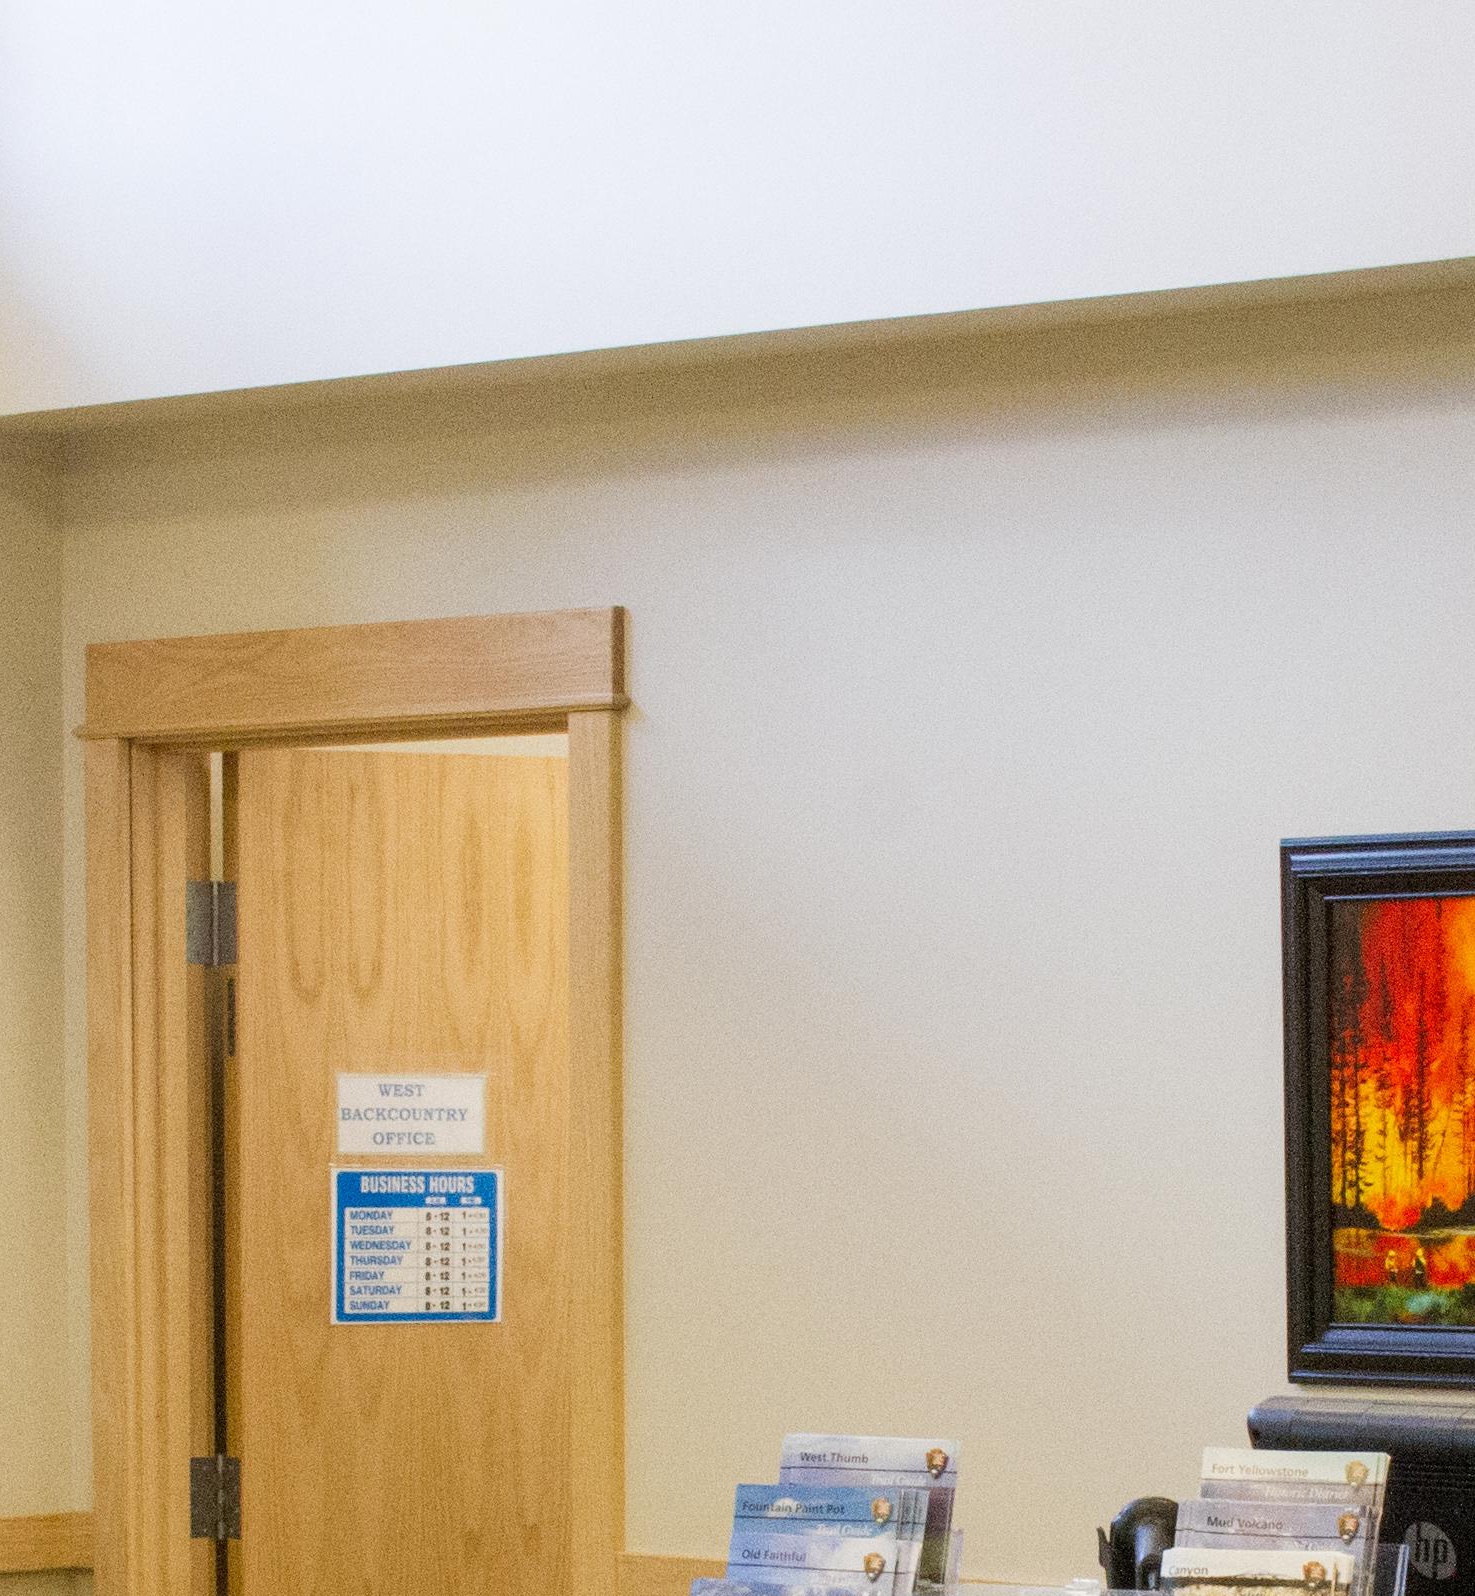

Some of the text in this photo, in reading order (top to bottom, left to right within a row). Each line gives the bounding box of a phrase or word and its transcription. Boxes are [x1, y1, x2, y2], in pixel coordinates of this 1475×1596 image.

[378, 1083, 426, 1098] WEST
[340, 1107, 469, 1123] BACKCOUNTRY
[373, 1131, 437, 1146] OFFICE
[360, 1175, 475, 1194] BUSINESS HOURS
[349, 1210, 393, 1221] MONDAY
[350, 1225, 395, 1236] TUESDAY
[349, 1240, 412, 1251] WEDNESDAY
[350, 1255, 403, 1266] THURSDAY
[349, 1270, 385, 1281] FRIDAY
[349, 1285, 403, 1296] SATURDAY
[349, 1301, 390, 1311] SUNDAY
[799, 1450, 869, 1466] West Thumb
[1212, 1463, 1309, 1478] Fort Yellowstone
[742, 1500, 846, 1516] Fountain Paint Pot
[1207, 1516, 1284, 1531] Mud Volcano
[742, 1548, 807, 1563] Old Faithful
[1168, 1564, 1209, 1578] Canyon
